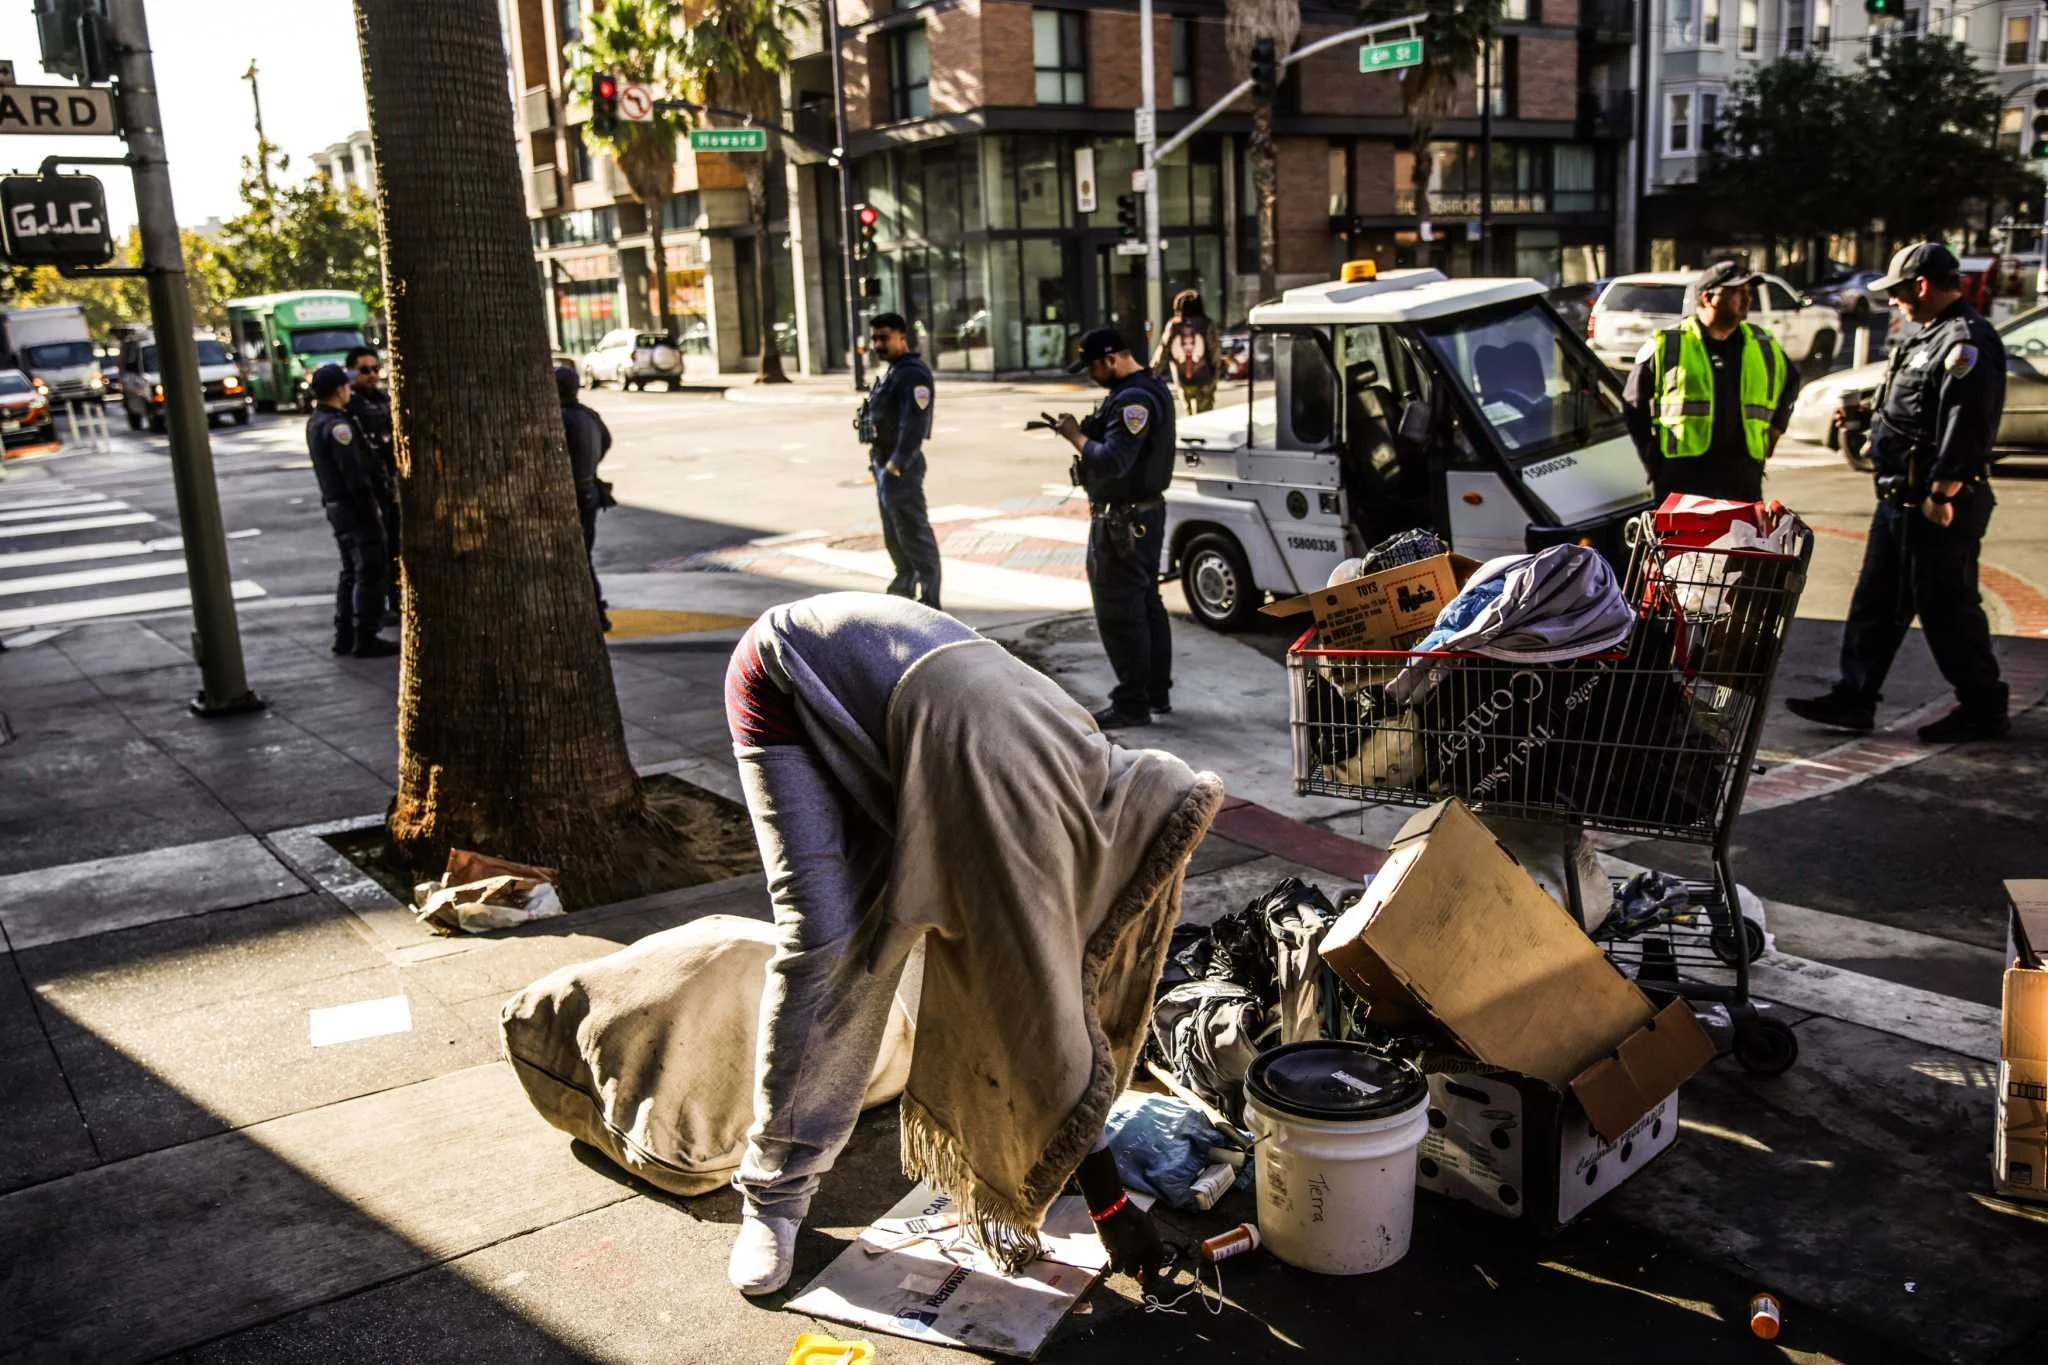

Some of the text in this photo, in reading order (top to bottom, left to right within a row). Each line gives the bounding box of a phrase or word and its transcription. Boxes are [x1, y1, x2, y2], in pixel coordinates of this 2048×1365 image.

[698, 132, 756, 146] Howard
[1287, 536, 1337, 552] 15800336
[1356, 581, 1378, 597] TOYS
[1307, 1173, 1331, 1223] Tierra
[924, 1267, 973, 1309] Renown
